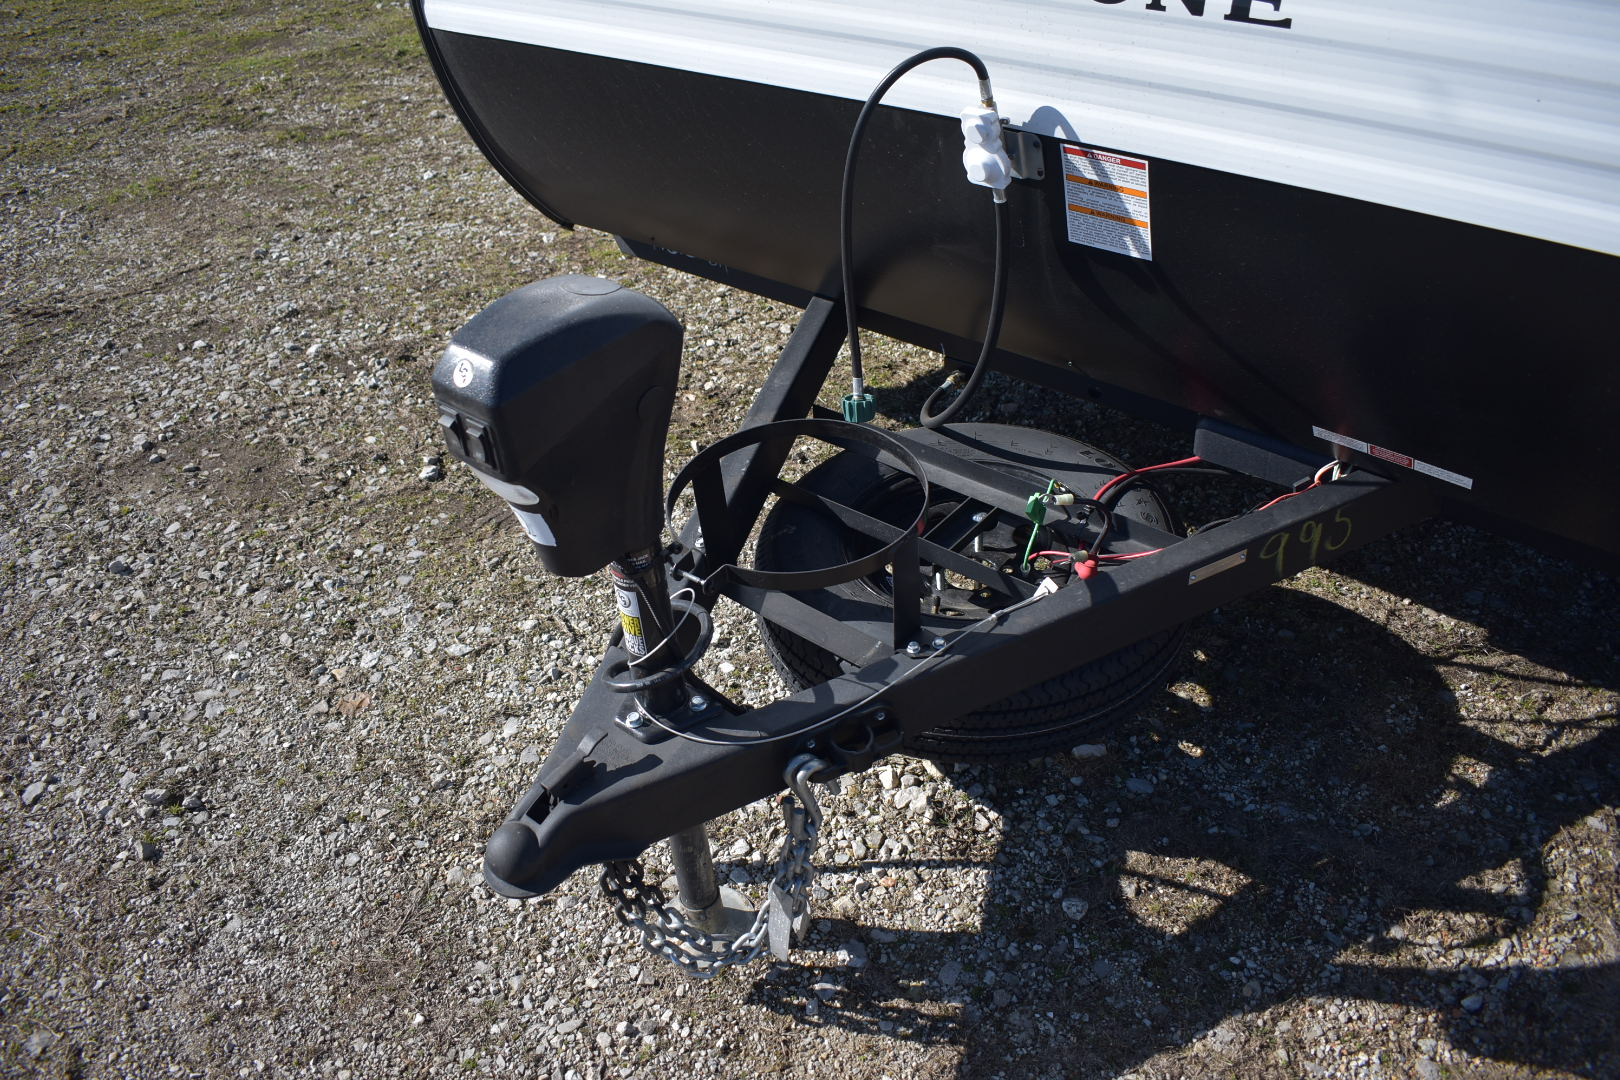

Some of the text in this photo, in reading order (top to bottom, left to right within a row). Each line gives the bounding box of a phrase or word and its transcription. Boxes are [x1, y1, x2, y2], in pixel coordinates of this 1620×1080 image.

[1094, 152, 1121, 165] DANGER
[1095, 210, 1126, 223] WARNING
[1260, 508, 1352, 576] 995
